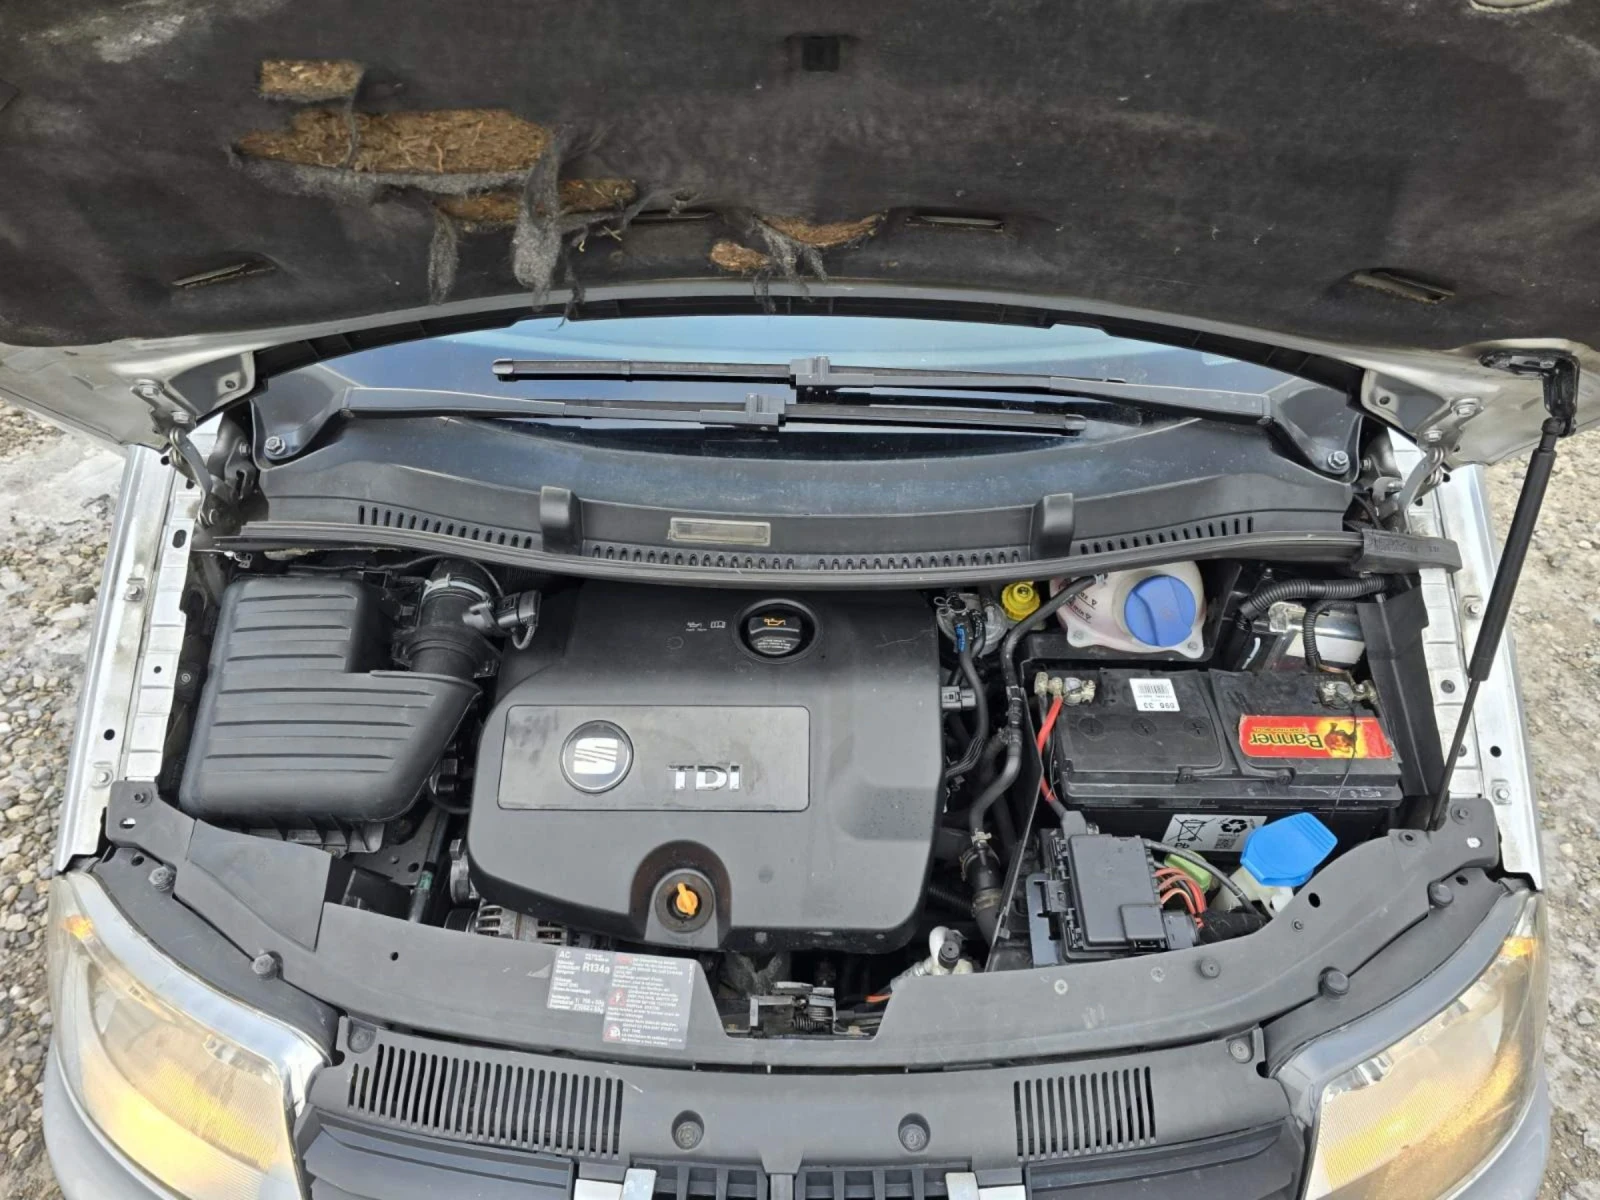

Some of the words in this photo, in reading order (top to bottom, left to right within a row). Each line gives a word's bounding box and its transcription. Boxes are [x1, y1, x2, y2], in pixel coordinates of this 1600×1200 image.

[1250, 733, 1324, 749] Banner
[667, 764, 741, 791] TDI
[559, 950, 571, 959] AC
[582, 961, 611, 974] R134a
